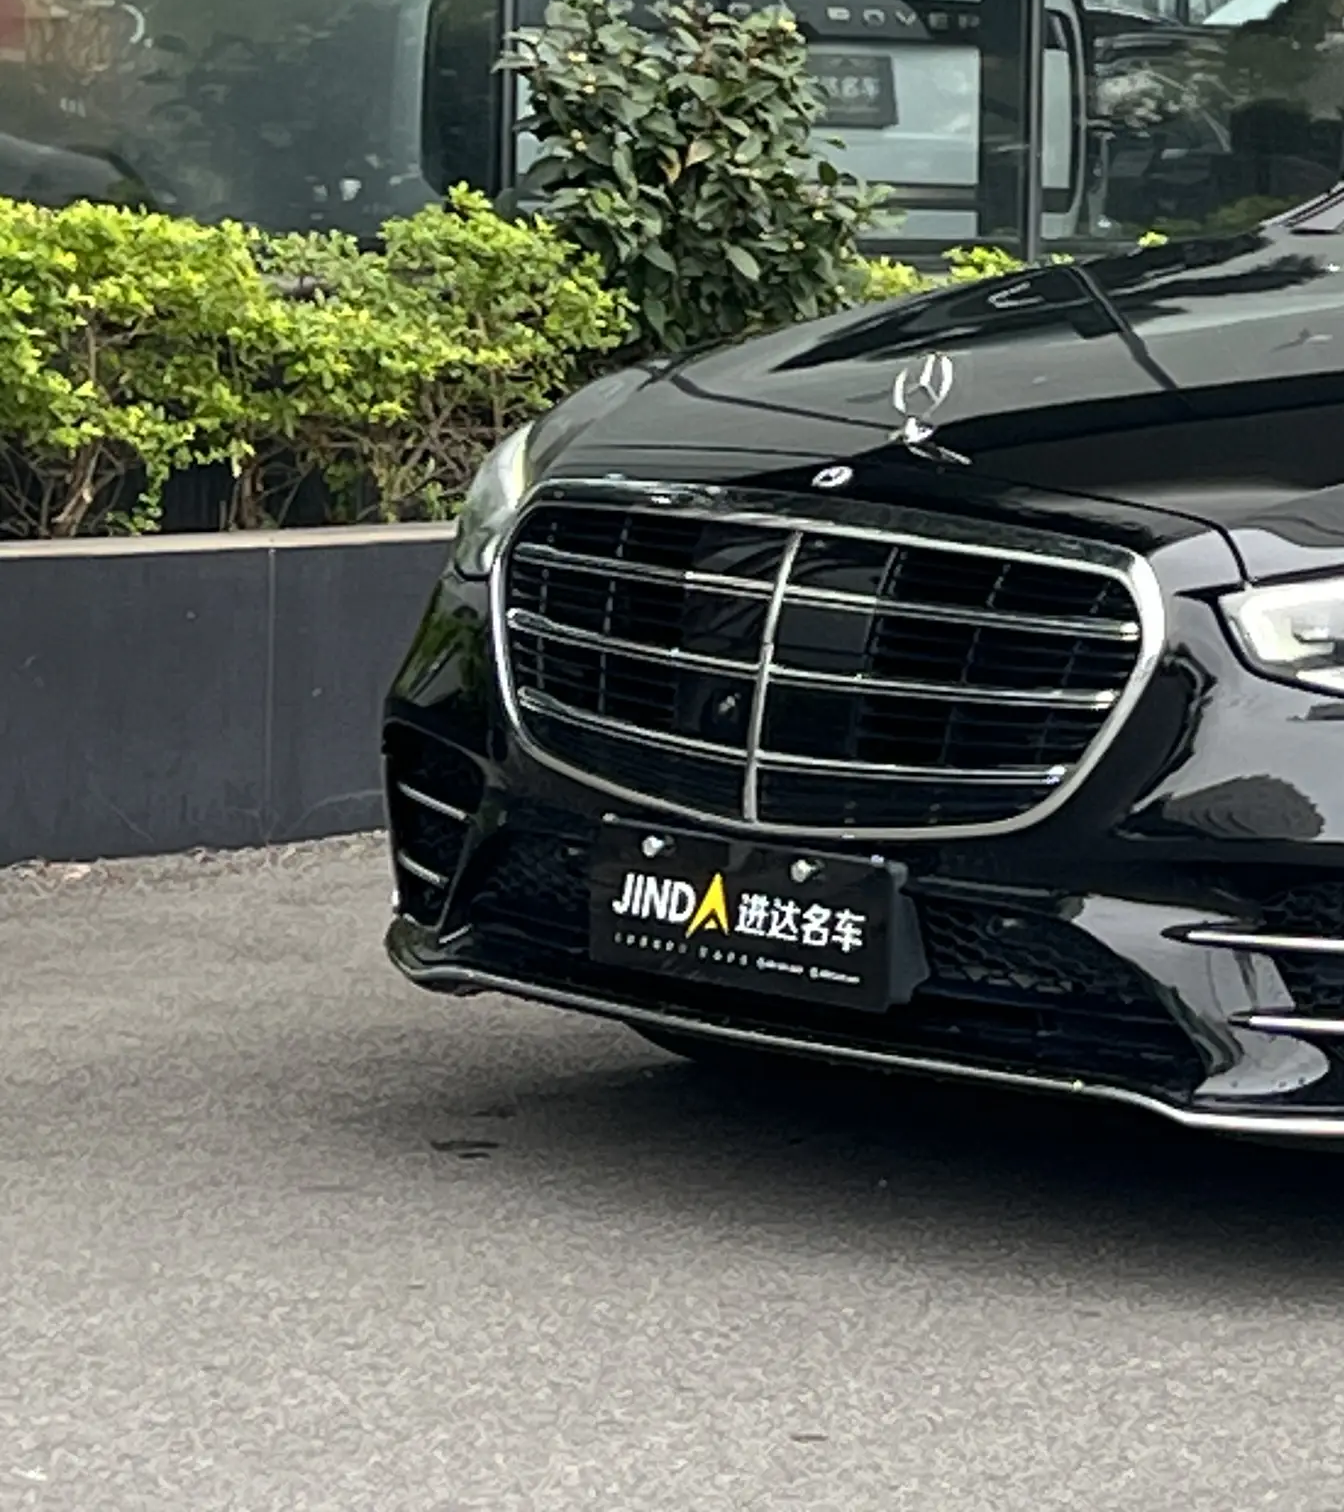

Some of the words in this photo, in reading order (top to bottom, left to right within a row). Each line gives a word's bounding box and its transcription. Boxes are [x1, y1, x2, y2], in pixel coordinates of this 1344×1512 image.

[612, 871, 729, 938] JINDA
[734, 893, 866, 953] 进达名车
